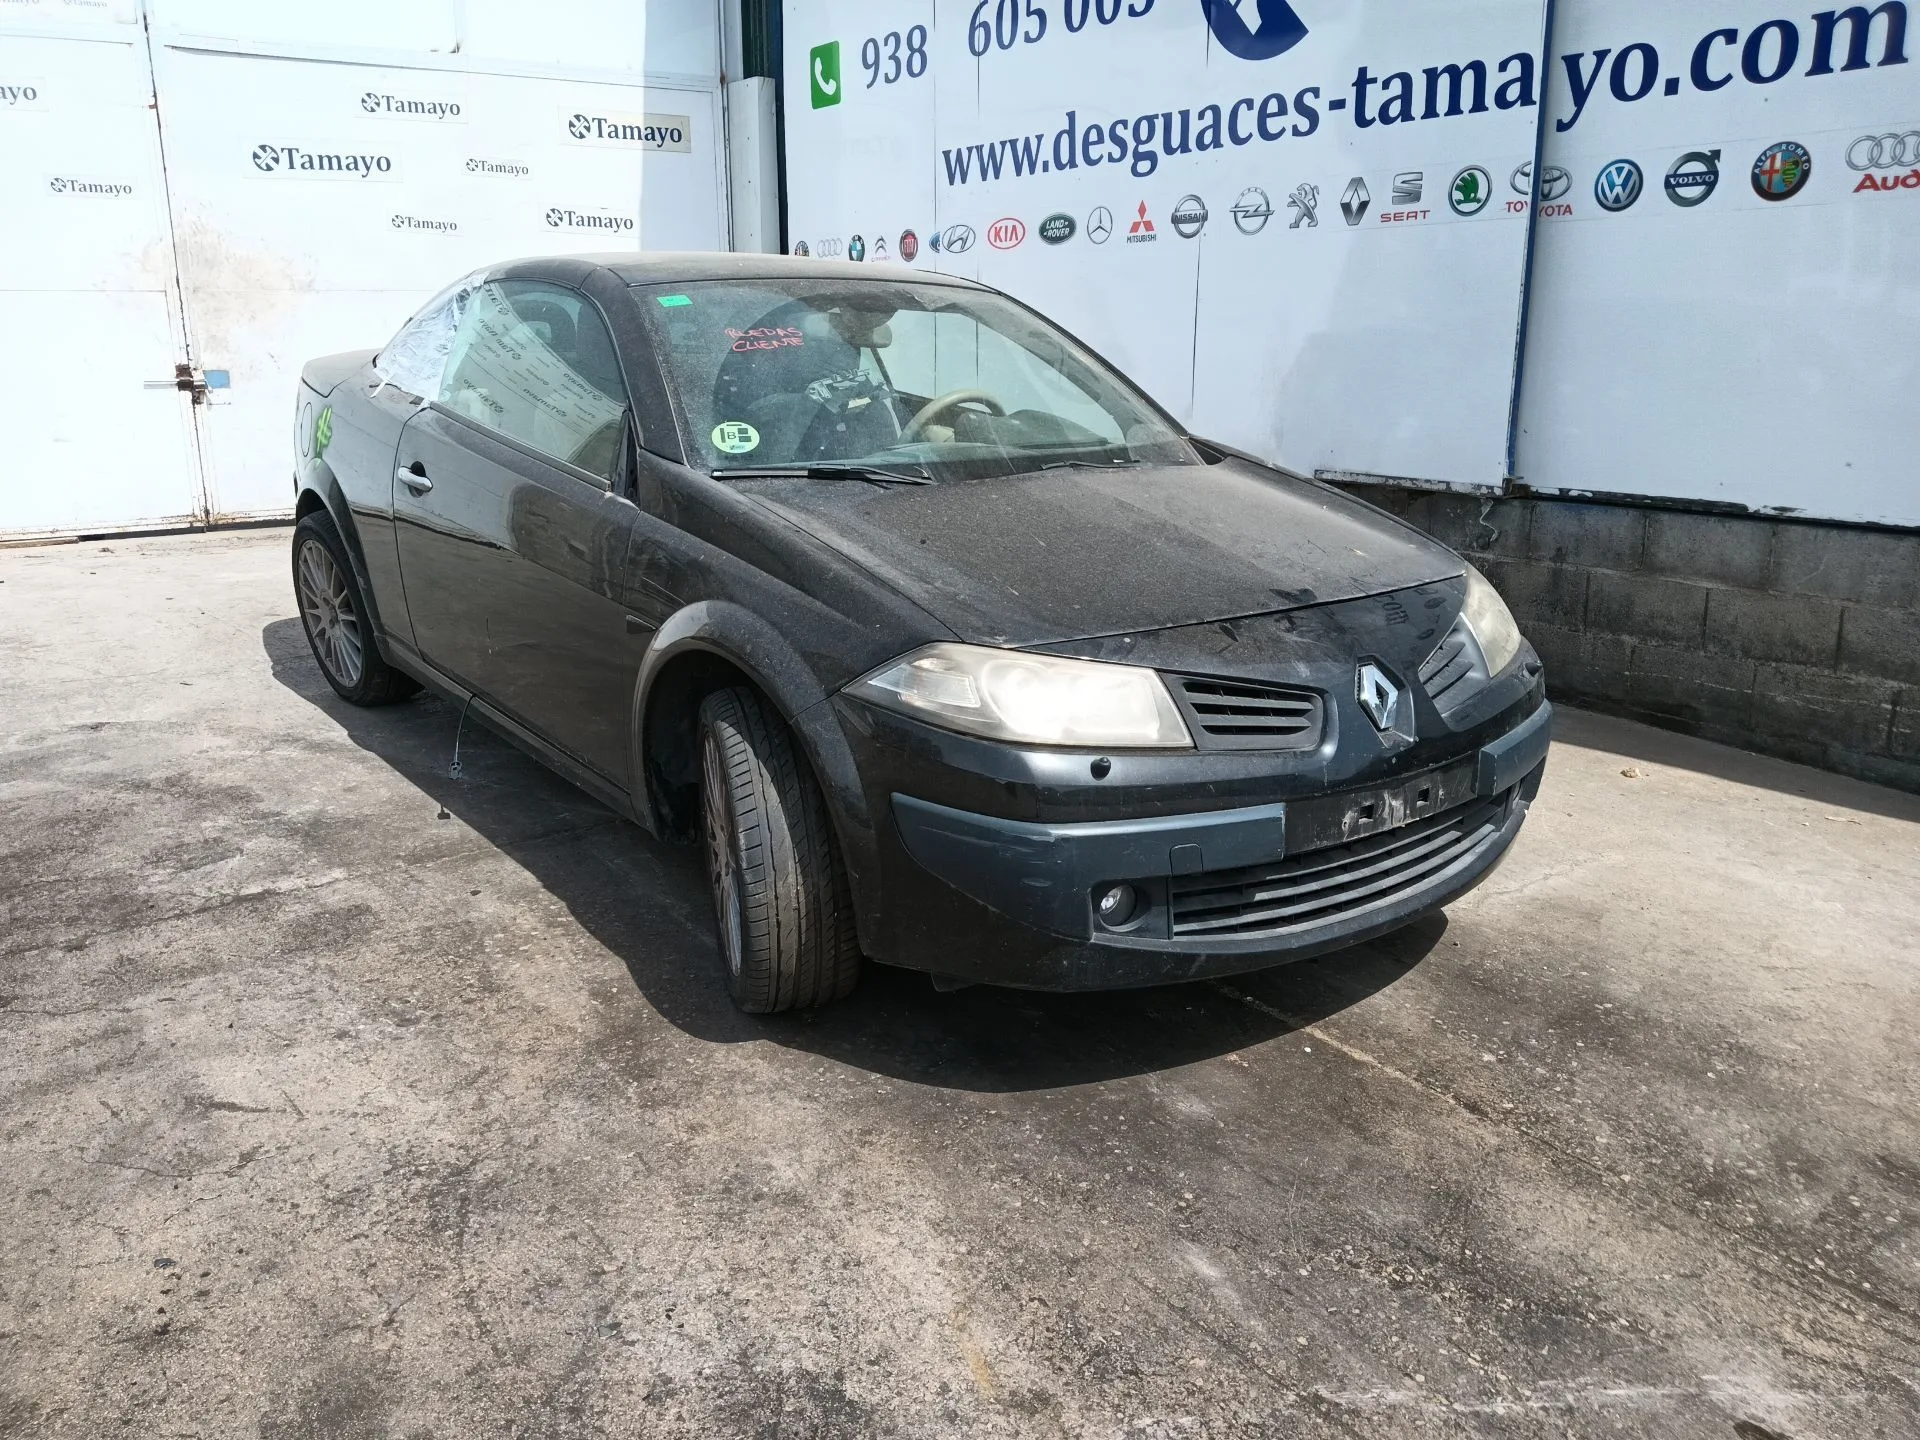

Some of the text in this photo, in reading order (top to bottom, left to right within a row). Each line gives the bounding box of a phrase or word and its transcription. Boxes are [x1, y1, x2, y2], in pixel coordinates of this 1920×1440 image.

[861, 24, 928, 89] 938
[942, 0, 1909, 187] www.desguaces-tamayo.com
[382, 95, 461, 120] Tamayo
[592, 118, 683, 147] Tamayo
[281, 147, 391, 178] Tamayo
[1781, 143, 1810, 170] ROMEO
[479, 160, 529, 176] Tamayo
[67, 179, 132, 197] Tamayo
[1669, 174, 1715, 185] VOLVO
[405, 216, 458, 232] Tamayo
[564, 210, 634, 232] Tamayo
[1046, 219, 1065, 229] LAND
[1174, 212, 1205, 222] NISSAN
[1380, 209, 1431, 223] SEAT
[994, 224, 1019, 243] KIA
[1048, 227, 1070, 237] ROVER
[1127, 234, 1157, 243] MITSUBISHI
